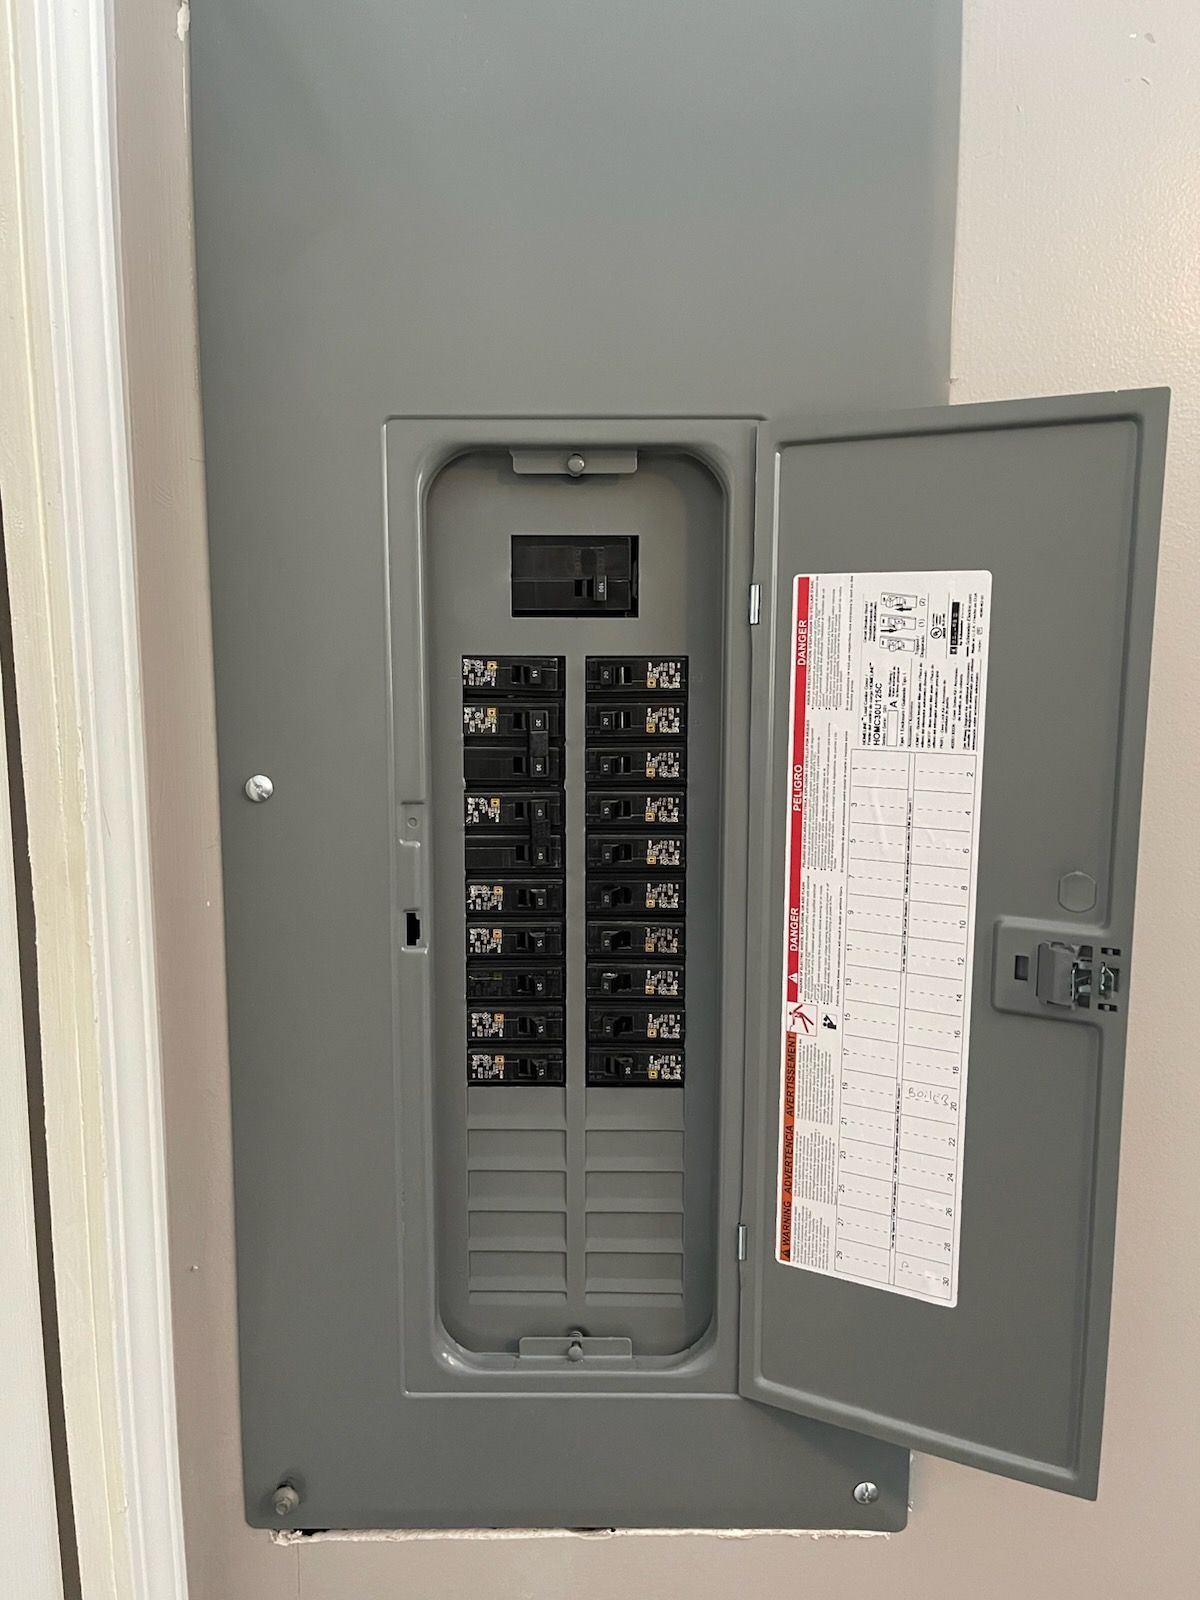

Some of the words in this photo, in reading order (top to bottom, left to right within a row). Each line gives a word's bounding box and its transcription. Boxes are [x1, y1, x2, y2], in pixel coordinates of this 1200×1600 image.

[797, 619, 807, 665] DANGER
[872, 682, 882, 746] HOMC30U125C
[793, 764, 803, 811] PELIGRO
[789, 906, 799, 952] DANGER
[958, 919, 966, 929] 10
[846, 943, 852, 951] 11
[956, 956, 964, 966] 12
[844, 976, 852, 986] 13
[955, 993, 962, 1002] 14
[843, 1011, 850, 1021] 15
[953, 1029, 961, 1039] 16
[842, 1047, 849, 1056] 17
[786, 1034, 796, 1117] AVERTISSEMENT
[951, 1065, 959, 1075] 18
[841, 1081, 848, 1090] 19
[949, 1100, 957, 1111] 20
[840, 1116, 847, 1125] 21
[947, 1136, 956, 1147] 22
[783, 1123, 793, 1194] ADVERTENCIA
[839, 1149, 846, 1159] 23
[946, 1171, 954, 1182] 24
[837, 1182, 845, 1193] 25
[944, 1206, 952, 1217] 26
[782, 1200, 791, 1247] WARNING
[836, 1216, 844, 1226] 27
[943, 1241, 951, 1252] 28
[835, 1249, 843, 1260] 29
[942, 1275, 949, 1286] 30
